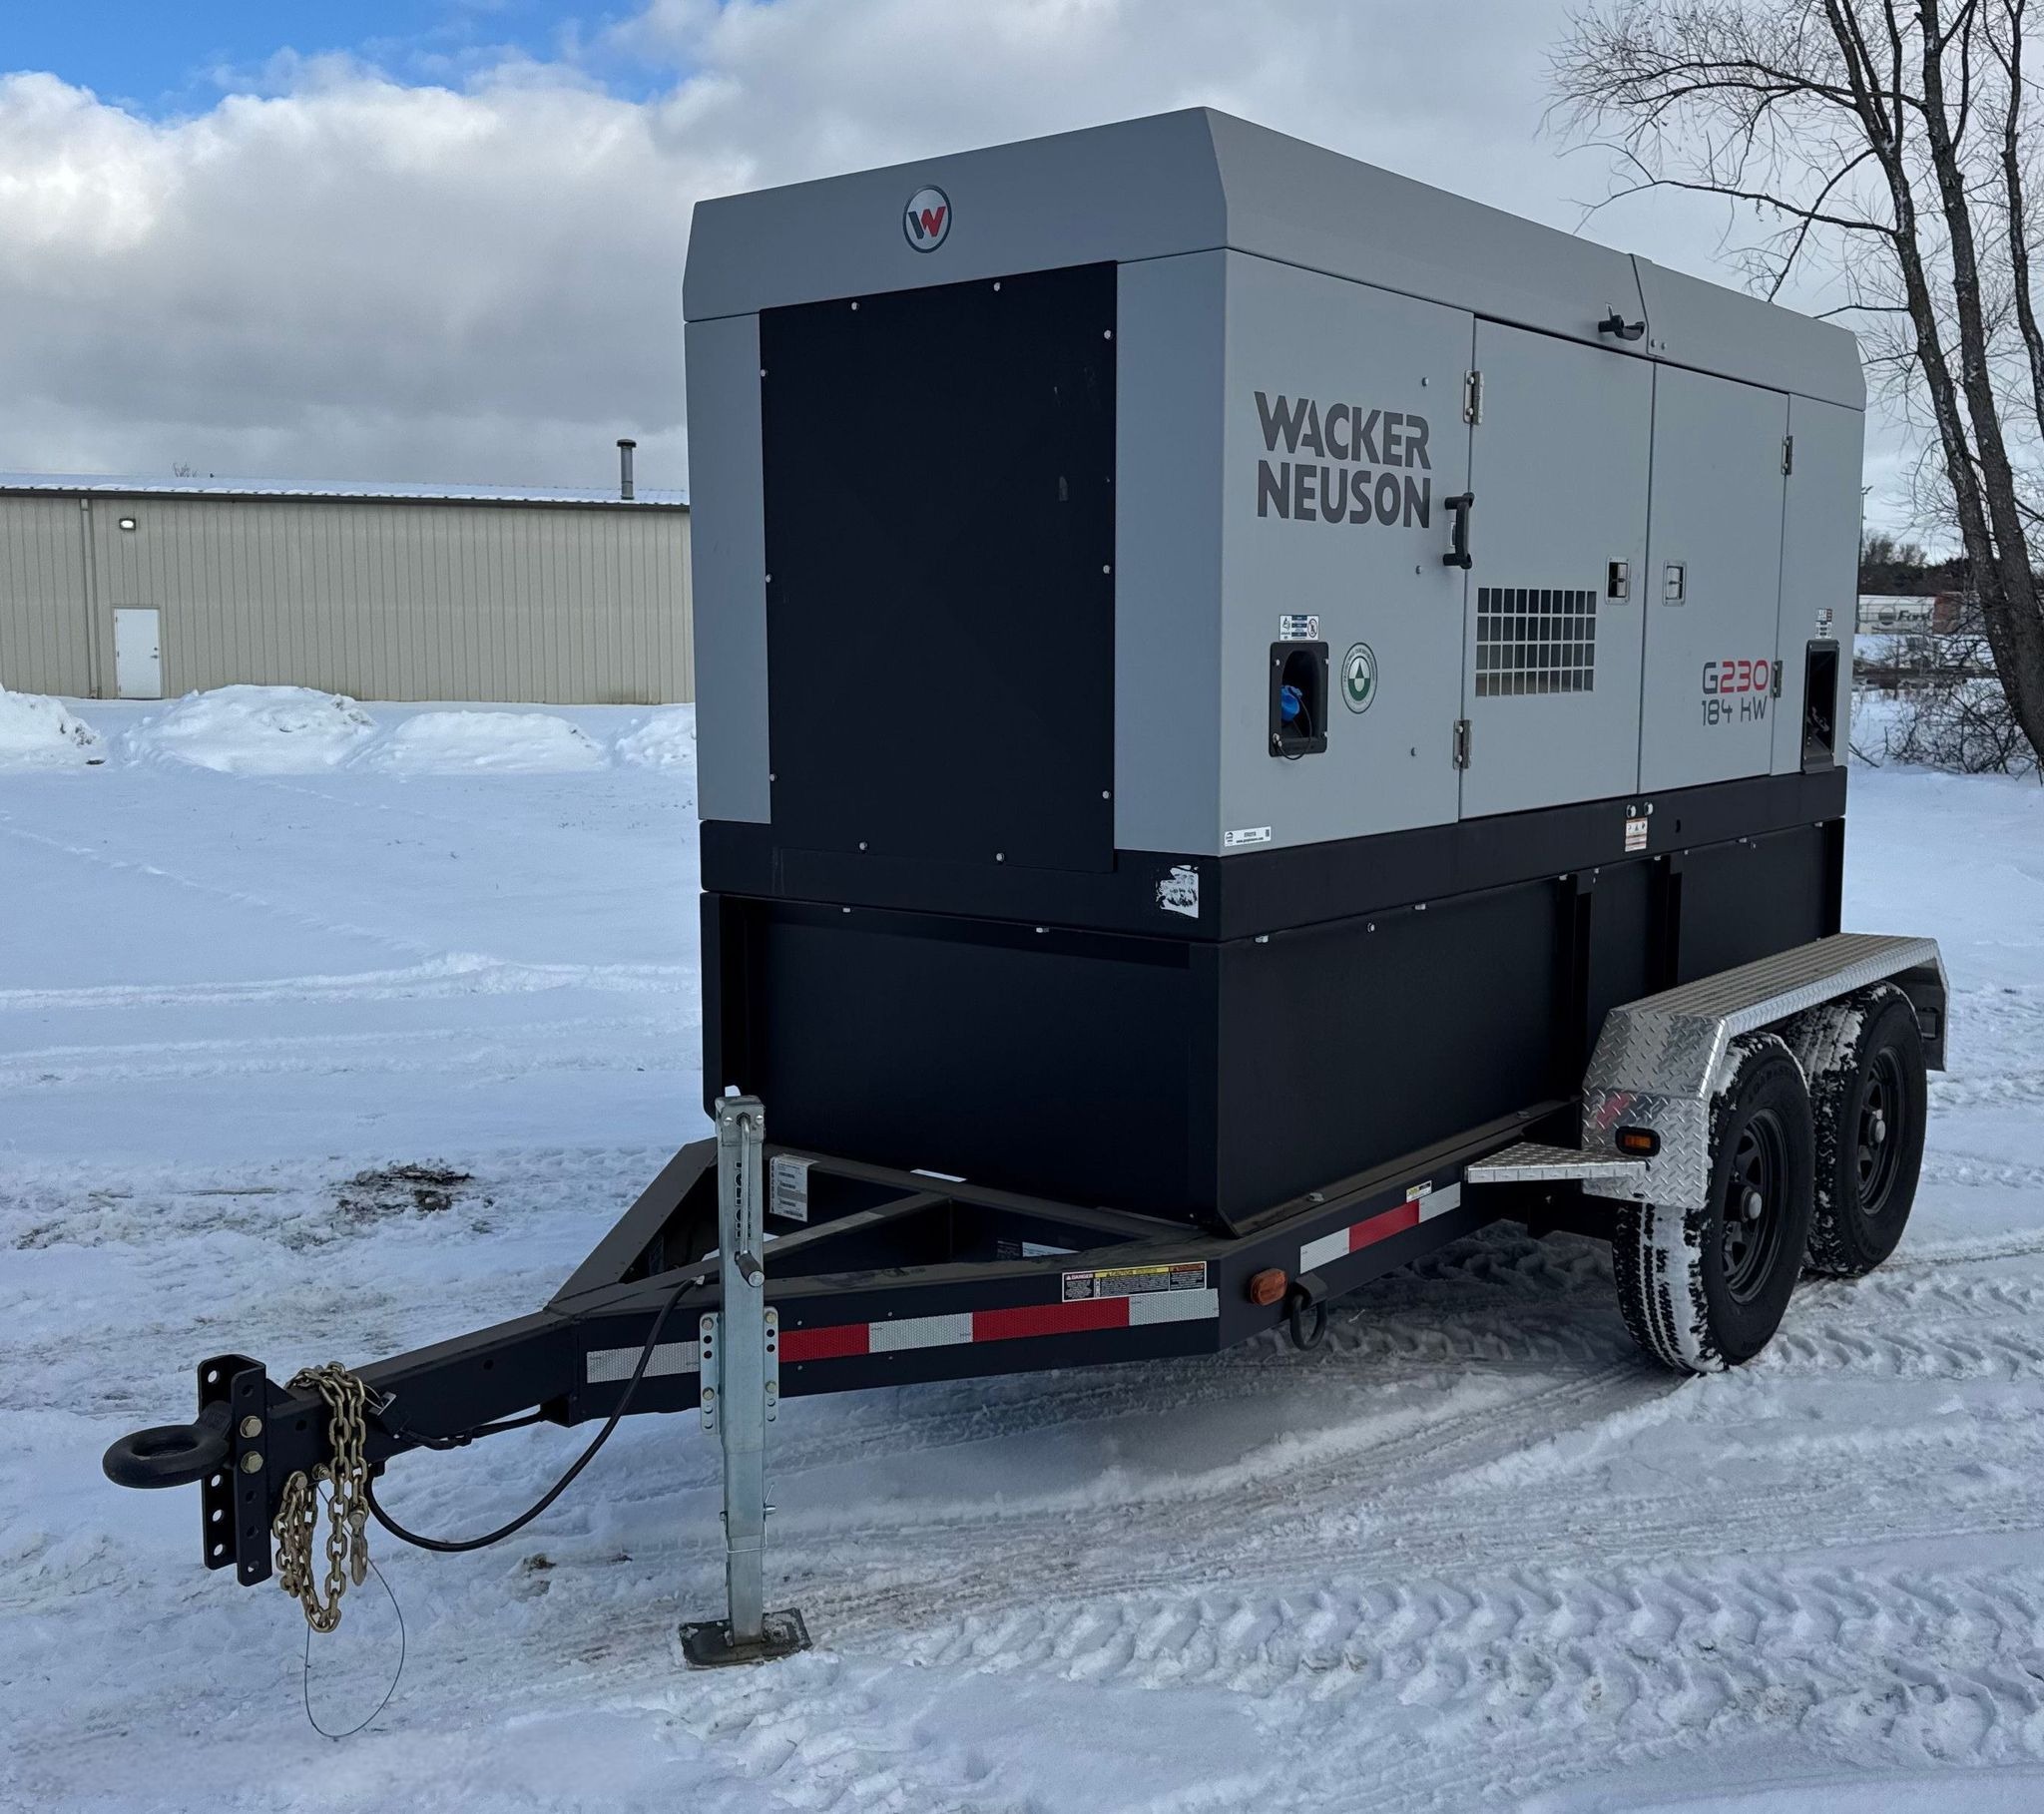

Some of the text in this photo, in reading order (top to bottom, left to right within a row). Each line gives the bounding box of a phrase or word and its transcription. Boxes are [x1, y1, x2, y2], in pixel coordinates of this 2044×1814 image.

[1254, 391, 1432, 470] WACKER
[1257, 460, 1431, 529] NEUSON
[1703, 660, 1769, 694] G230
[1702, 698, 1733, 726] 184
